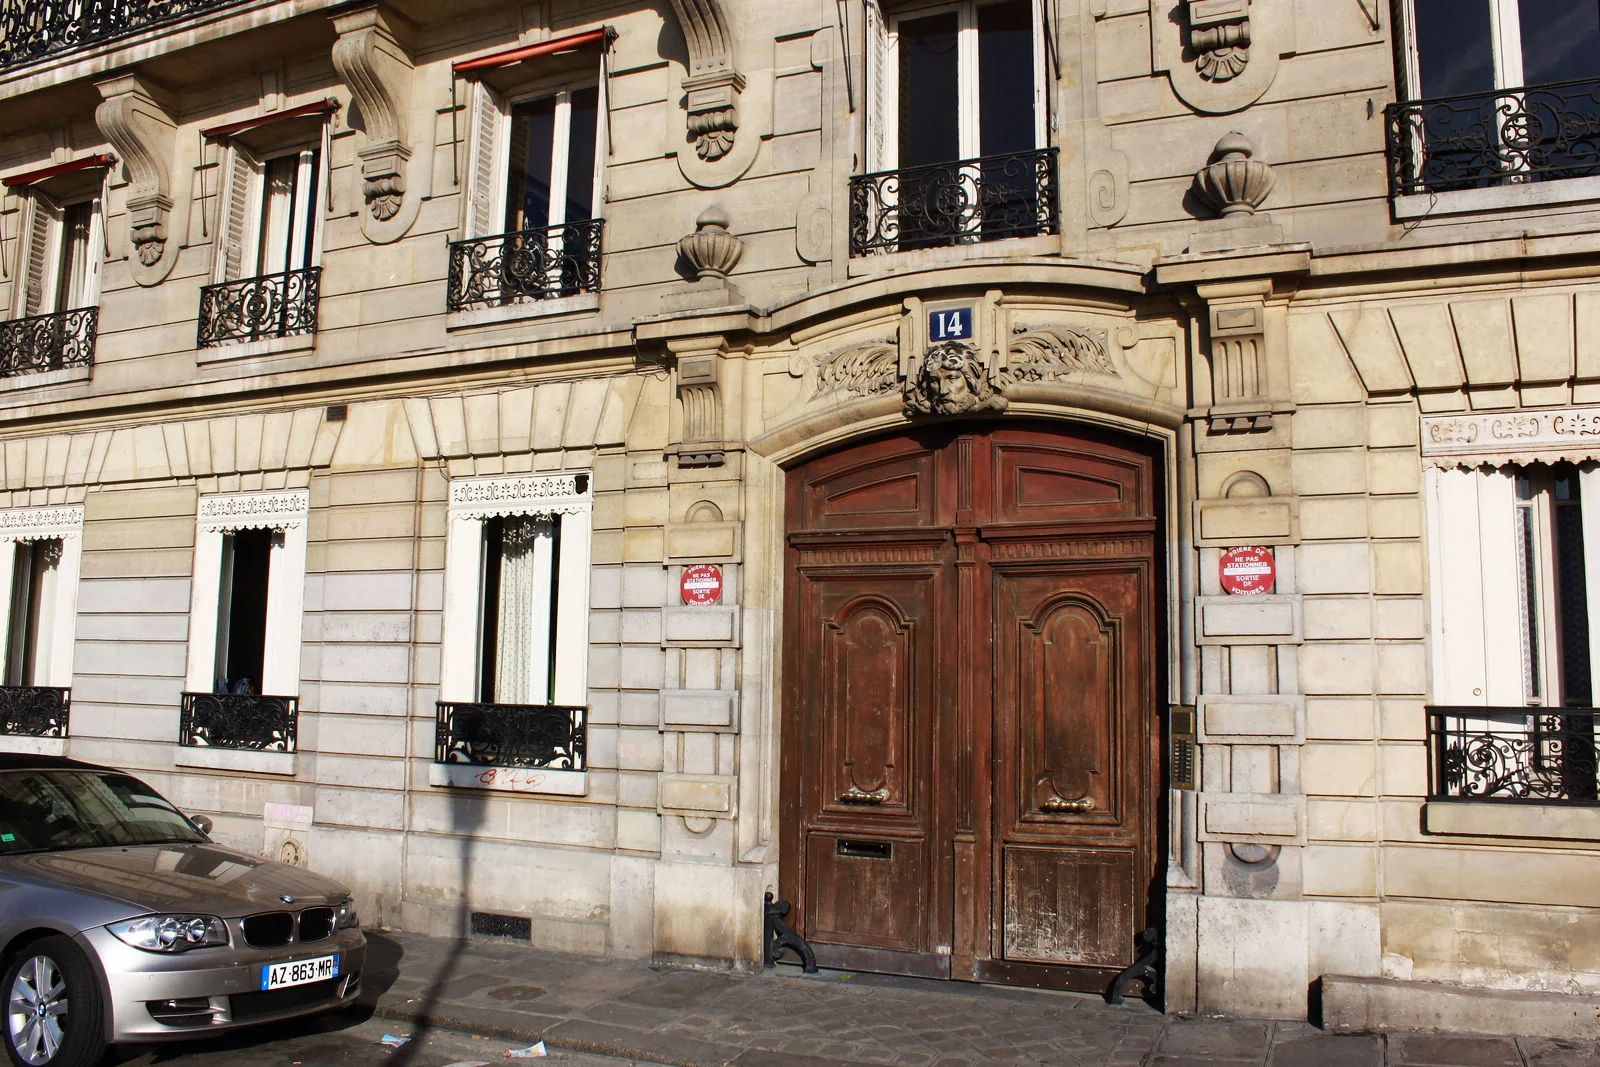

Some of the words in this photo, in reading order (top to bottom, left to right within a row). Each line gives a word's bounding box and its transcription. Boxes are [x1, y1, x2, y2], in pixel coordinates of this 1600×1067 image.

[938, 312, 963, 338] 14
[1255, 548, 1265, 557] DE
[1231, 585, 1265, 595] VOITURES
